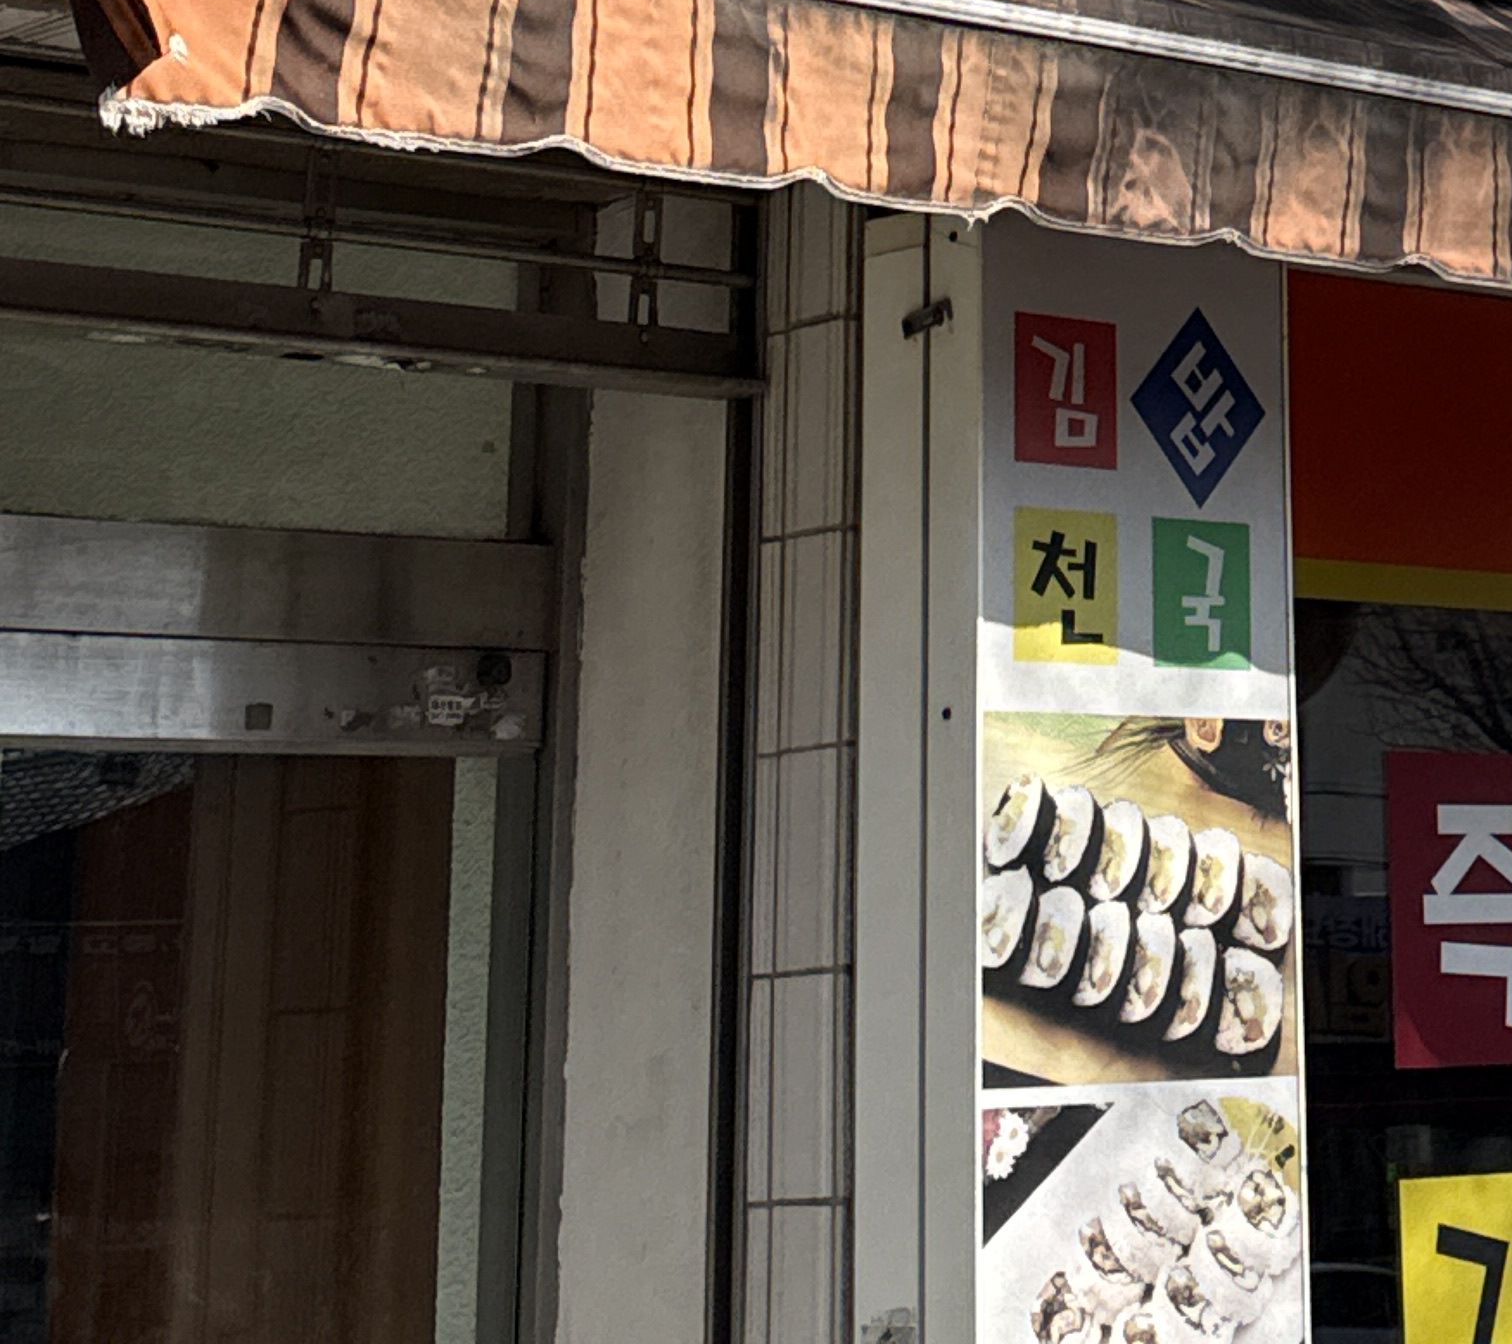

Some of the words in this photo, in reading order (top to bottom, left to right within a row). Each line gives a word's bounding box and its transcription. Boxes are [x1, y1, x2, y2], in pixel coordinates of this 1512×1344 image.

[1030, 334, 1099, 449] 김
[1169, 340, 1237, 477] 밥
[1030, 529, 1104, 646] 천
[1180, 534, 1226, 652] 국
